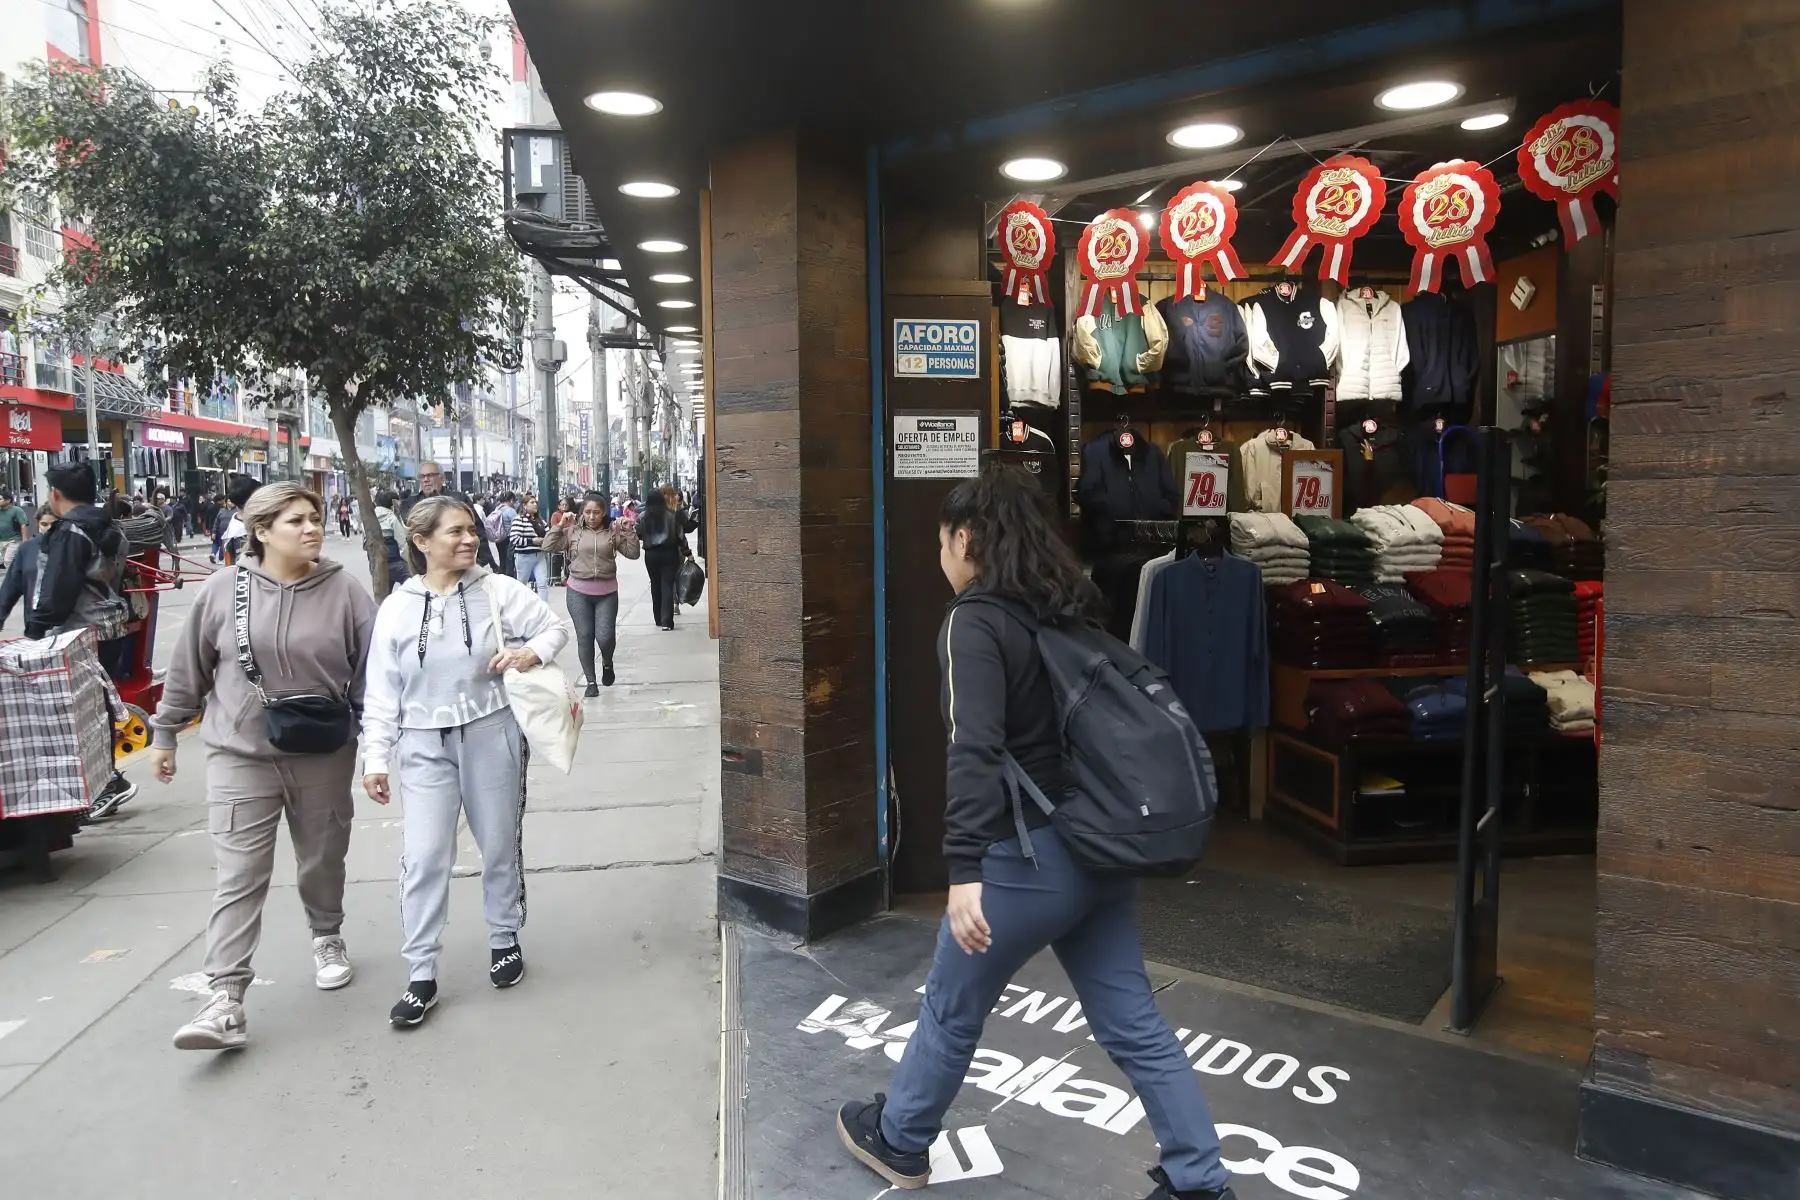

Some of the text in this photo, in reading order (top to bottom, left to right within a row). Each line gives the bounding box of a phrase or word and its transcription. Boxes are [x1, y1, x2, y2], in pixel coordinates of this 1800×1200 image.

[1551, 126, 1598, 176] 28
[1562, 160, 1613, 192] Julio
[1315, 185, 1361, 215] 28
[1426, 189, 1471, 224] 28
[1182, 204, 1214, 240] 28
[1307, 213, 1349, 236] Julio
[1425, 223, 1473, 247] Julio
[1013, 226, 1039, 250] 28
[1096, 233, 1129, 259] 28
[899, 325, 974, 344] AFORO
[905, 357, 975, 369] 12 PERSONAS
[898, 432, 975, 442] OFERTA DE EMPLEO
[1185, 471, 1225, 508] 79.90
[1293, 476, 1330, 509] 79.90
[490, 951, 521, 973] DKNY
